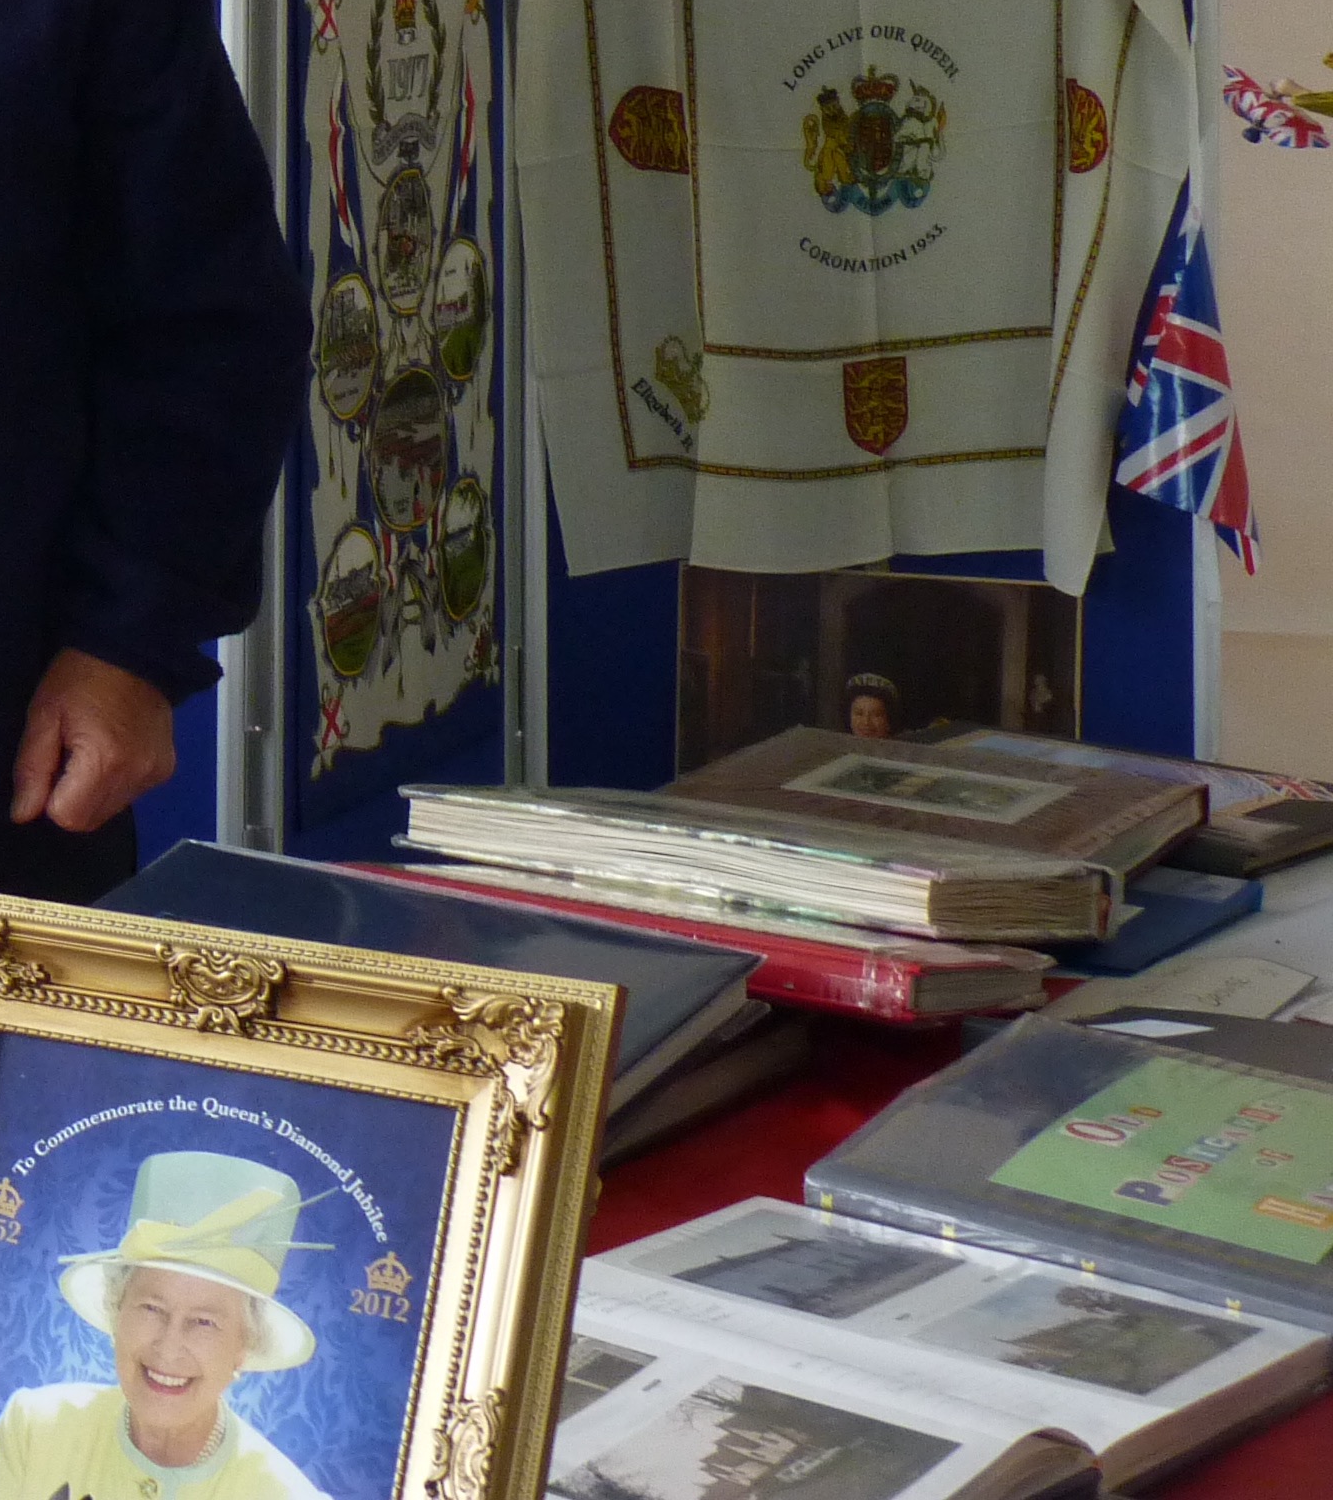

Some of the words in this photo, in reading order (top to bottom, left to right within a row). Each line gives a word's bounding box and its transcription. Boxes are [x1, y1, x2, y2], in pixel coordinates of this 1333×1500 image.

[783, 44, 825, 92] LONG
[826, 26, 864, 51] LIVE
[870, 25, 907, 44] OUR
[799, 236, 907, 273] CORONATION
[11, 1153, 36, 1178] To
[33, 1098, 164, 1156] Commemorate
[168, 1095, 198, 1112] the
[202, 1097, 273, 1130] Queen's
[275, 1118, 354, 1184] Diamond
[342, 1178, 389, 1244] Jubilee
[348, 1289, 410, 1322] 2012
